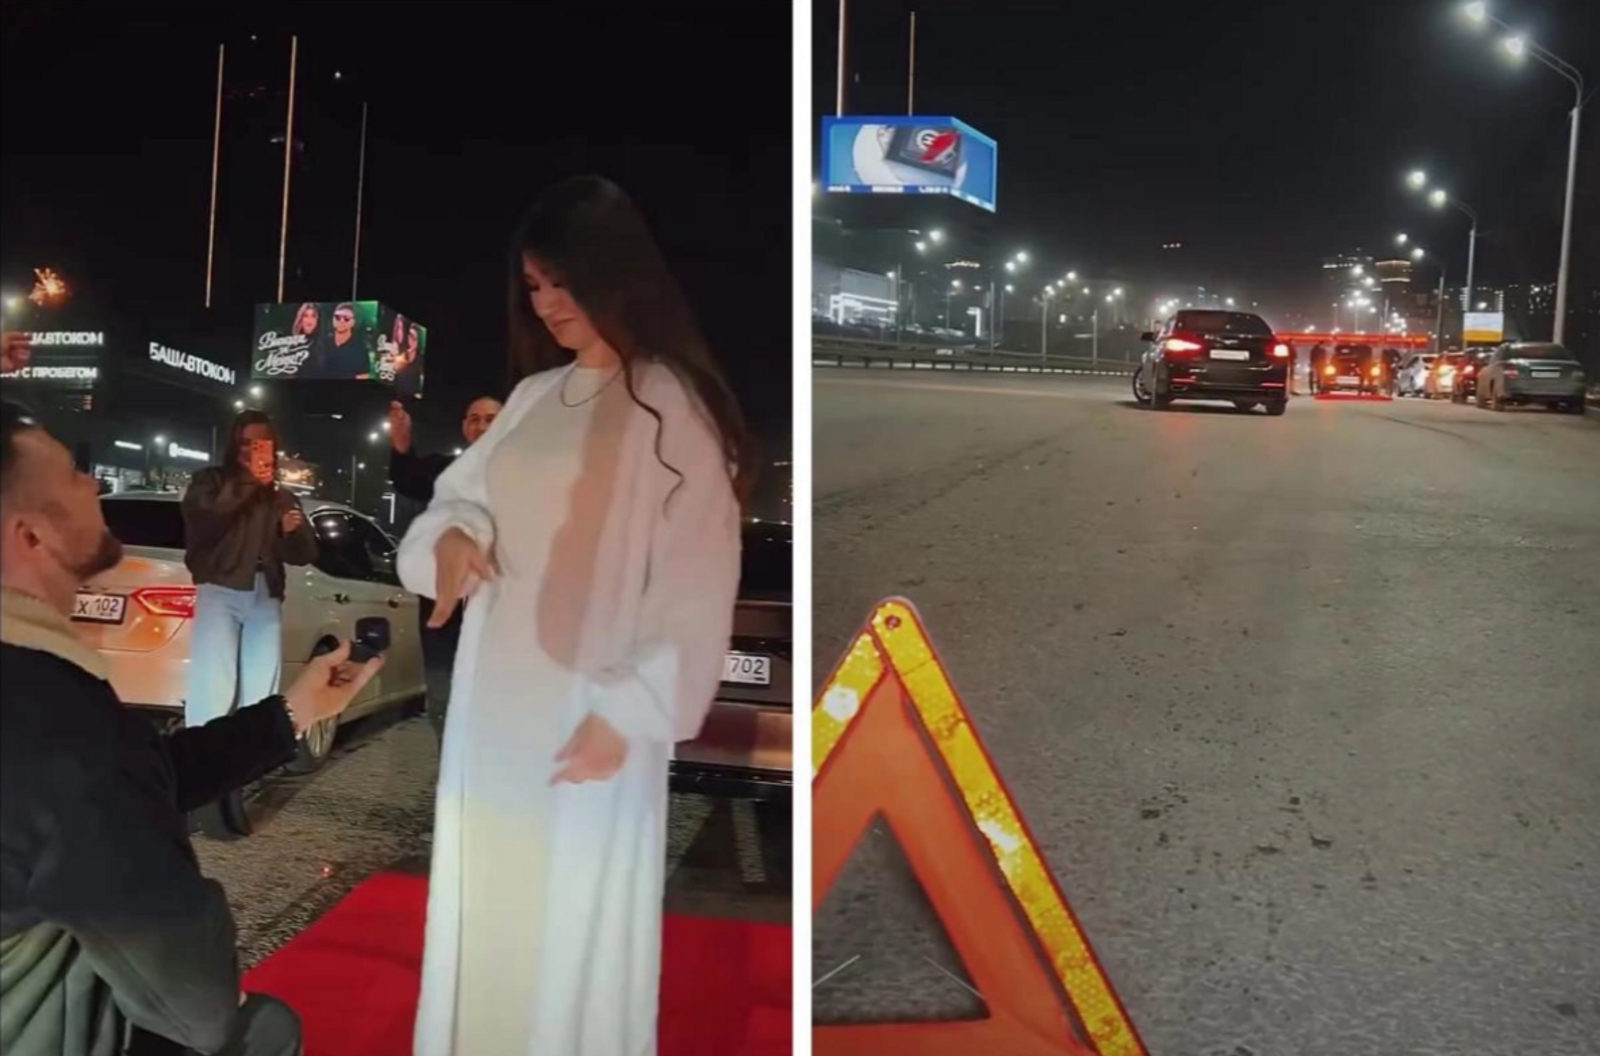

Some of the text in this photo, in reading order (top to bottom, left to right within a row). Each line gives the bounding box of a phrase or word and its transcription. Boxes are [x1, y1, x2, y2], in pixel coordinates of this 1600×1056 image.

[149, 341, 236, 385] БАШАВТОКОМ
[32, 367, 98, 378] ПРОБЕГОМ
[93, 598, 120, 612] 102
[730, 657, 765, 675] 702
